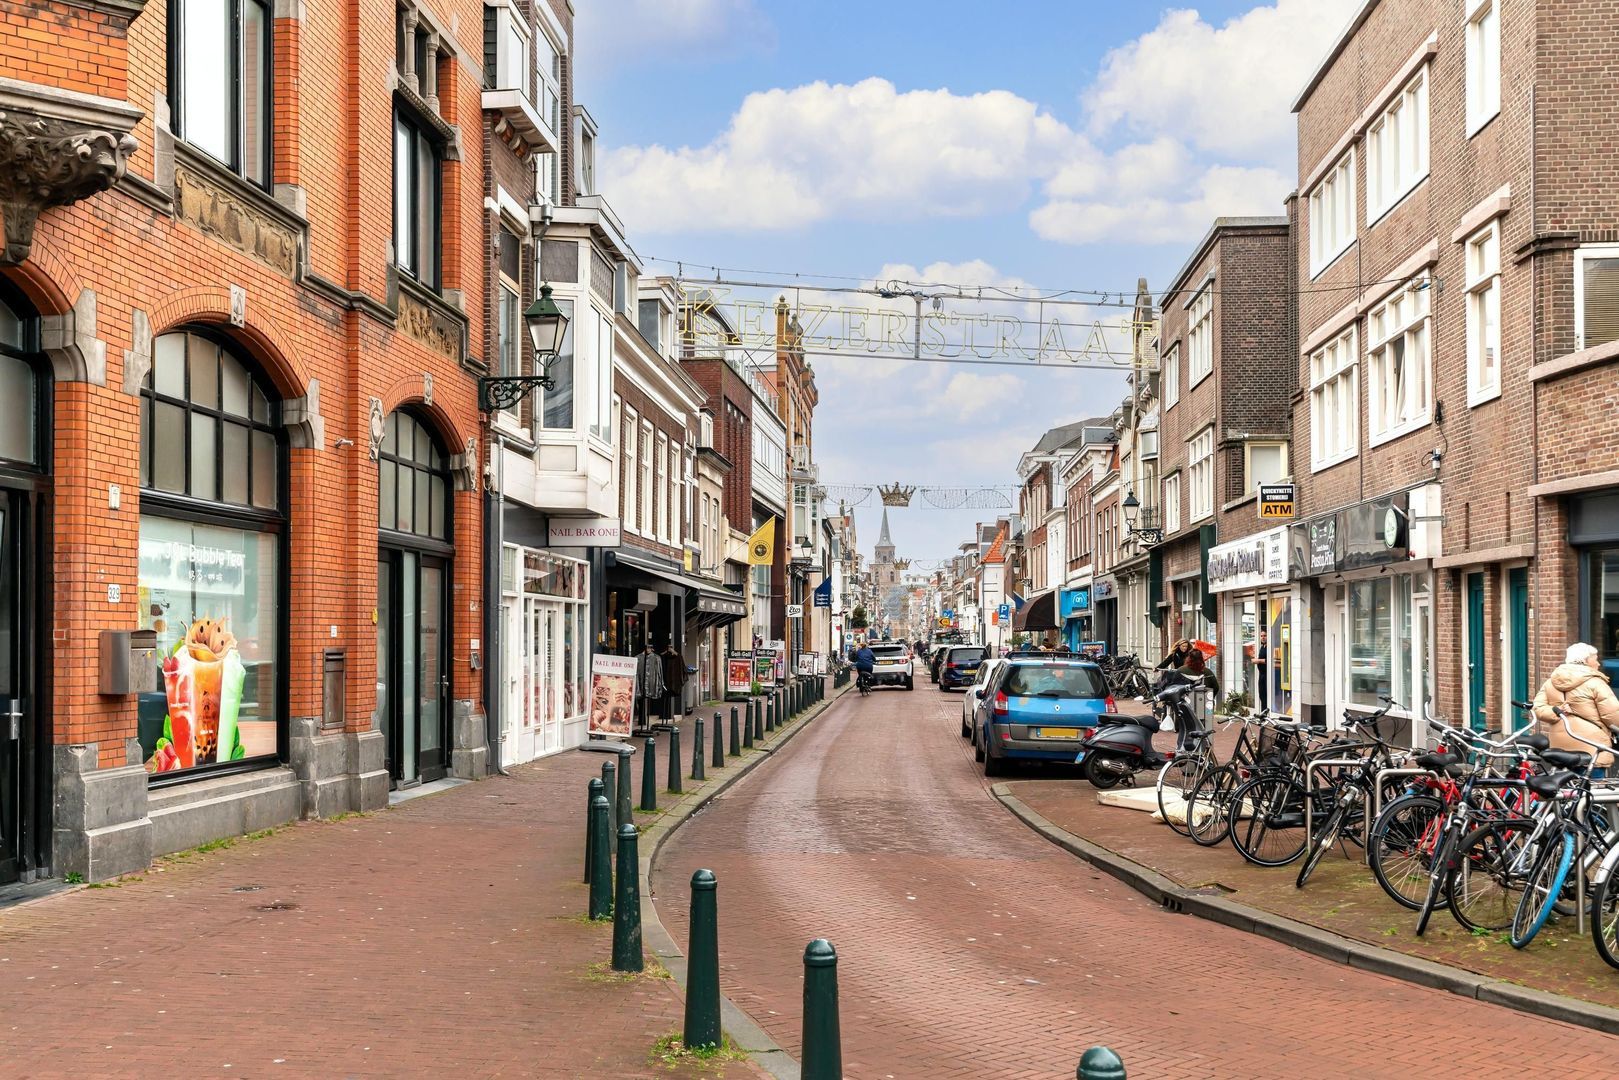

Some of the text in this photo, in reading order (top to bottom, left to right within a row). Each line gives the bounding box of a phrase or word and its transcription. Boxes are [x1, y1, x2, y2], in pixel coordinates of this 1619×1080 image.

[679, 285, 1159, 366] KEIZERSTRAAT
[1264, 505, 1291, 514] ATM
[550, 528, 618, 537] NAIL BAR ONE
[109, 587, 119, 599] 329
[789, 606, 801, 615] Etos
